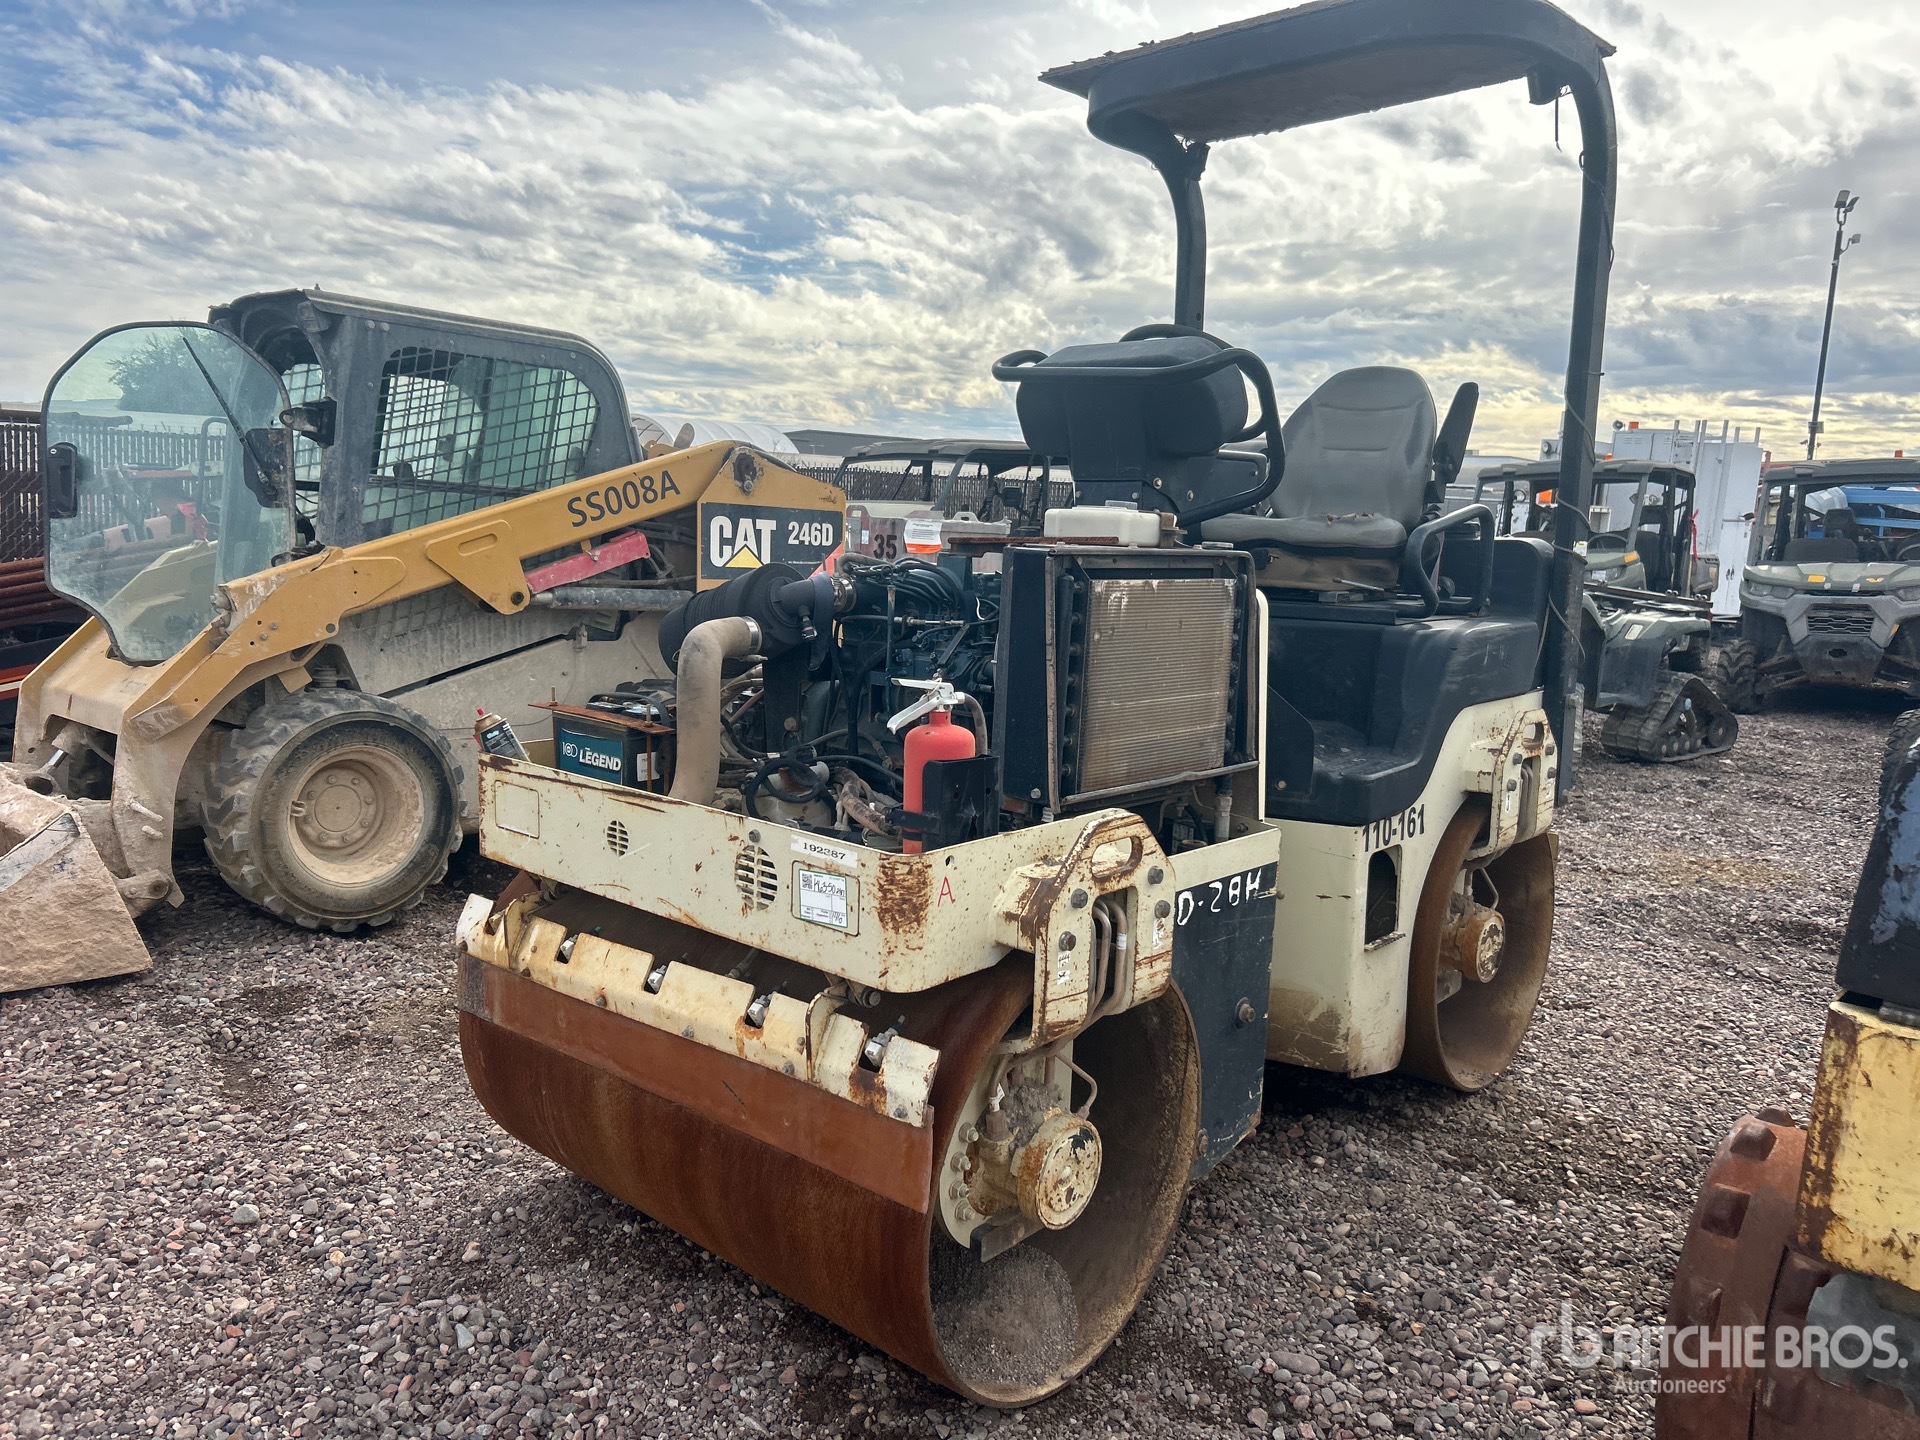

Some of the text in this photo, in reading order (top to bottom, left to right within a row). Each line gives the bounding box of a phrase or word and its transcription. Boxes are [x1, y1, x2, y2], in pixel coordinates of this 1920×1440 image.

[567, 470, 681, 528] SS008A
[710, 515, 834, 568] CAT 246D
[873, 533, 898, 560] 35
[579, 749, 621, 772] LEGEND
[1362, 803, 1425, 853] 110-161
[937, 876, 958, 907] A
